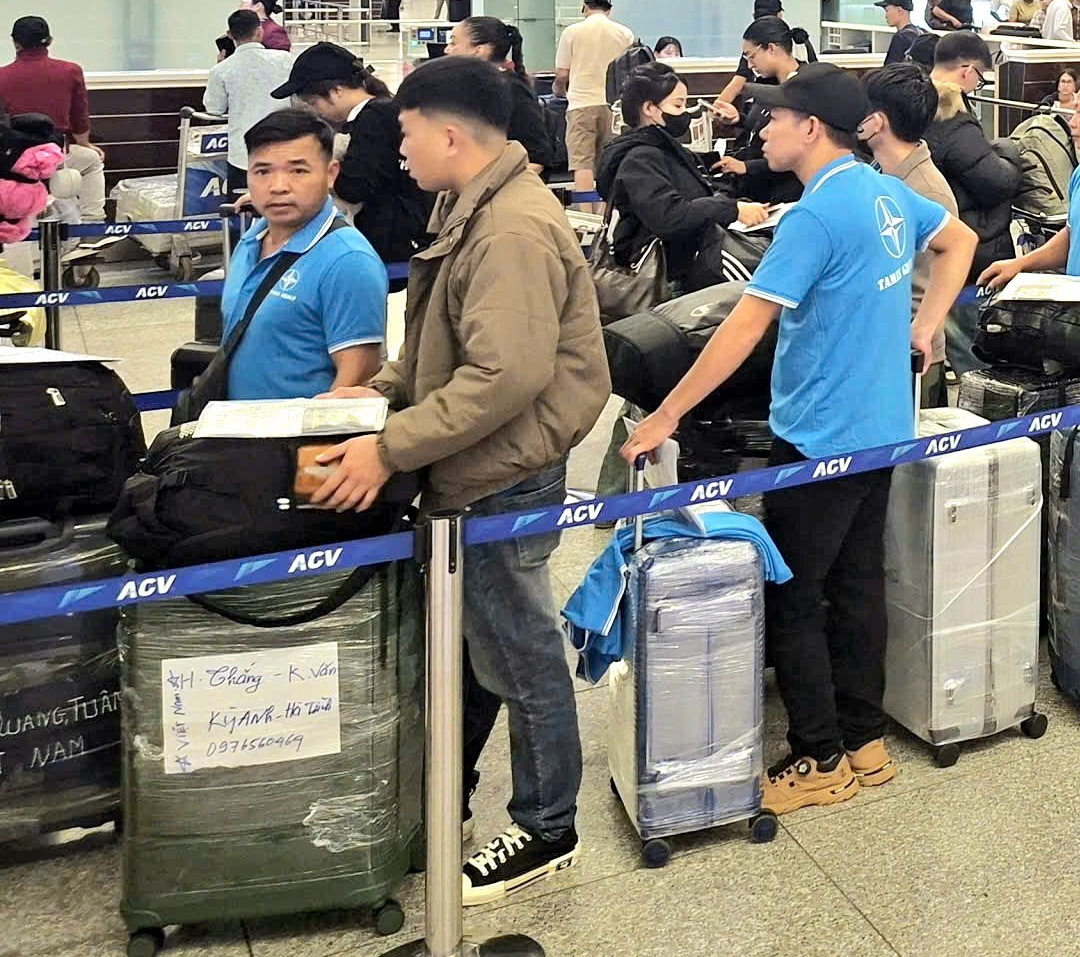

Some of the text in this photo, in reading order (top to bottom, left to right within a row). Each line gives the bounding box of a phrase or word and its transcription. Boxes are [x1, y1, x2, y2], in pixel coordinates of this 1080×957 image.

[206, 137, 228, 149] AC
[105, 221, 210, 234] ACV ACV
[35, 286, 168, 305] ACV ACV
[976, 286, 992, 297] AC
[556, 502, 604, 525] ACV
[690, 479, 733, 501] ACV
[812, 456, 852, 478] ACV
[925, 434, 961, 455] ACV
[1028, 412, 1063, 433] ACV
[116, 547, 343, 601] ACV ACV
[30, 735, 85, 767] NAM
